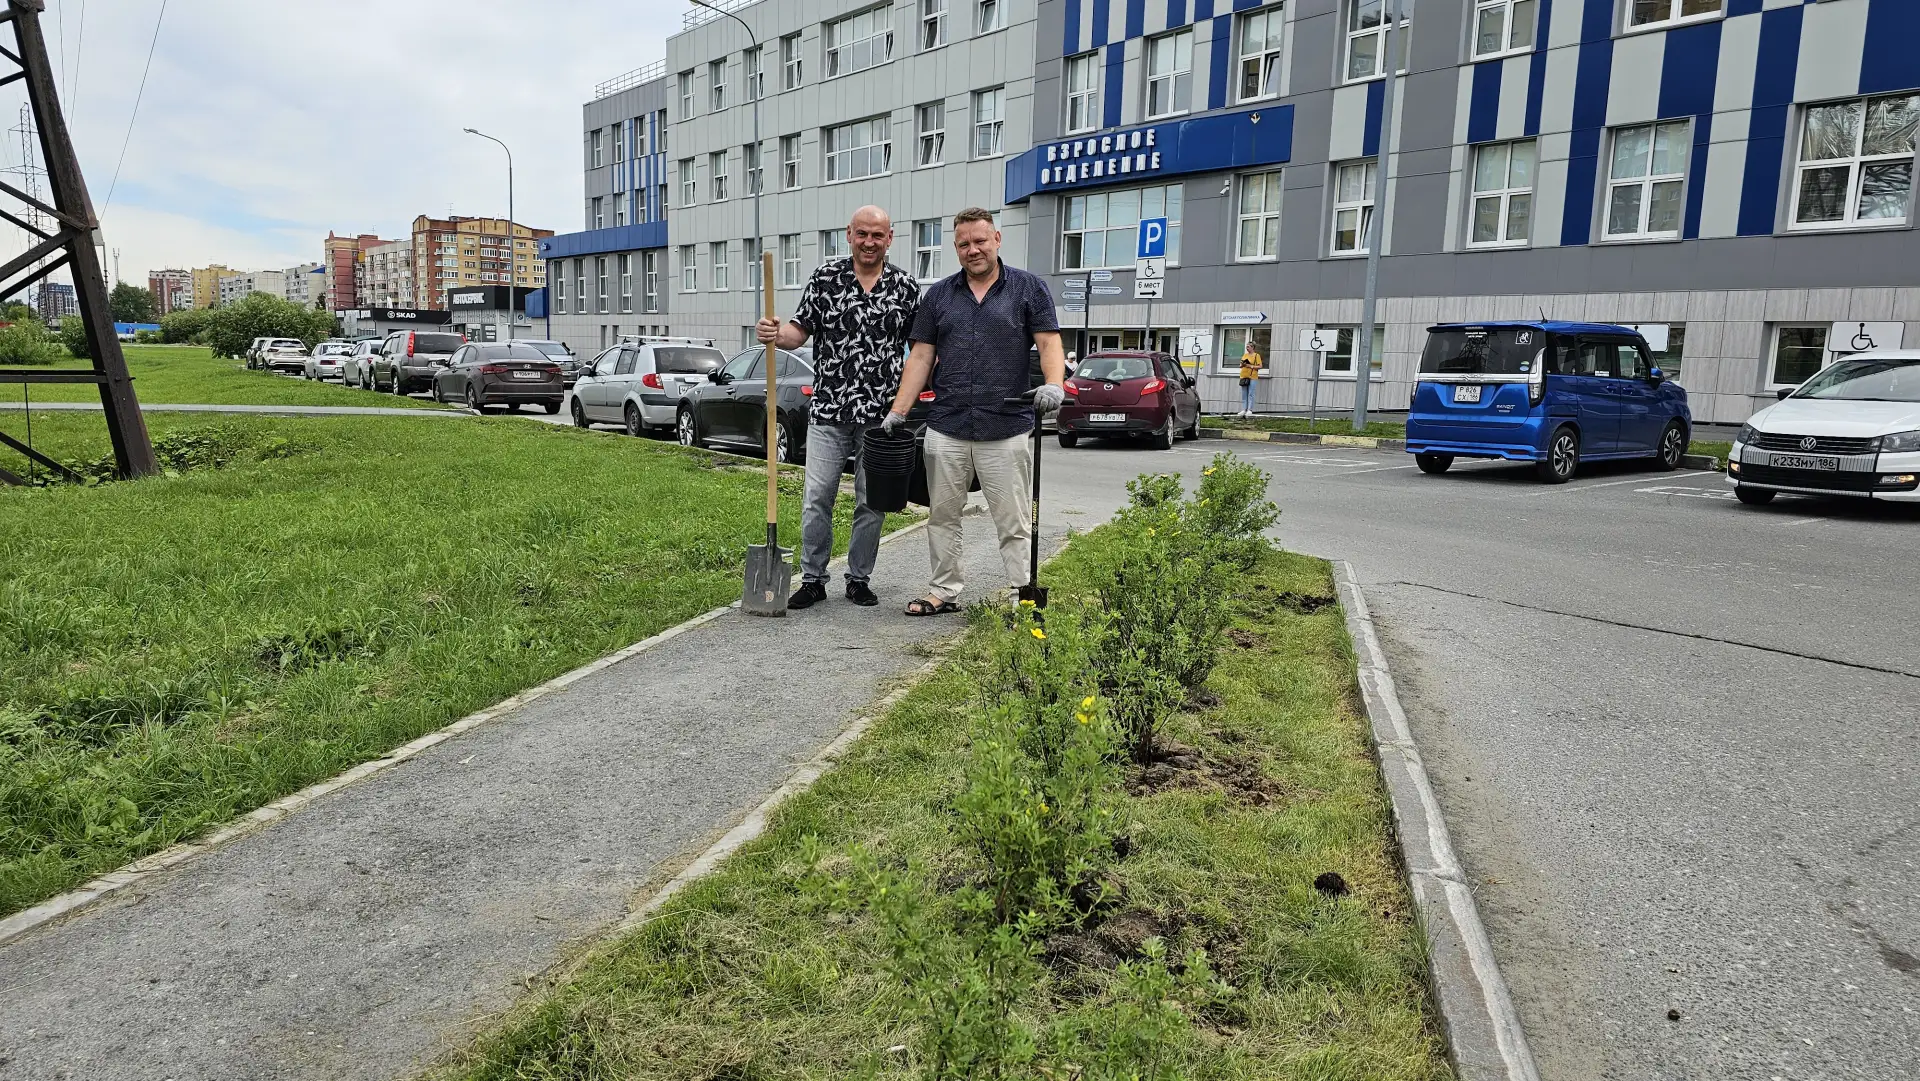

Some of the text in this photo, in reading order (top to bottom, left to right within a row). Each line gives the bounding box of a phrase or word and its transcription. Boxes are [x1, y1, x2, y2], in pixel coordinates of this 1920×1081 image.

[1047, 128, 1156, 162] ВЗРОСЛОЕ
[1041, 151, 1161, 184] ОТДЕЛЕНИЕ
[1145, 222, 1162, 254] P
[1138, 281, 1161, 289] 6 мест
[1773, 456, 1815, 468] К233МУ
